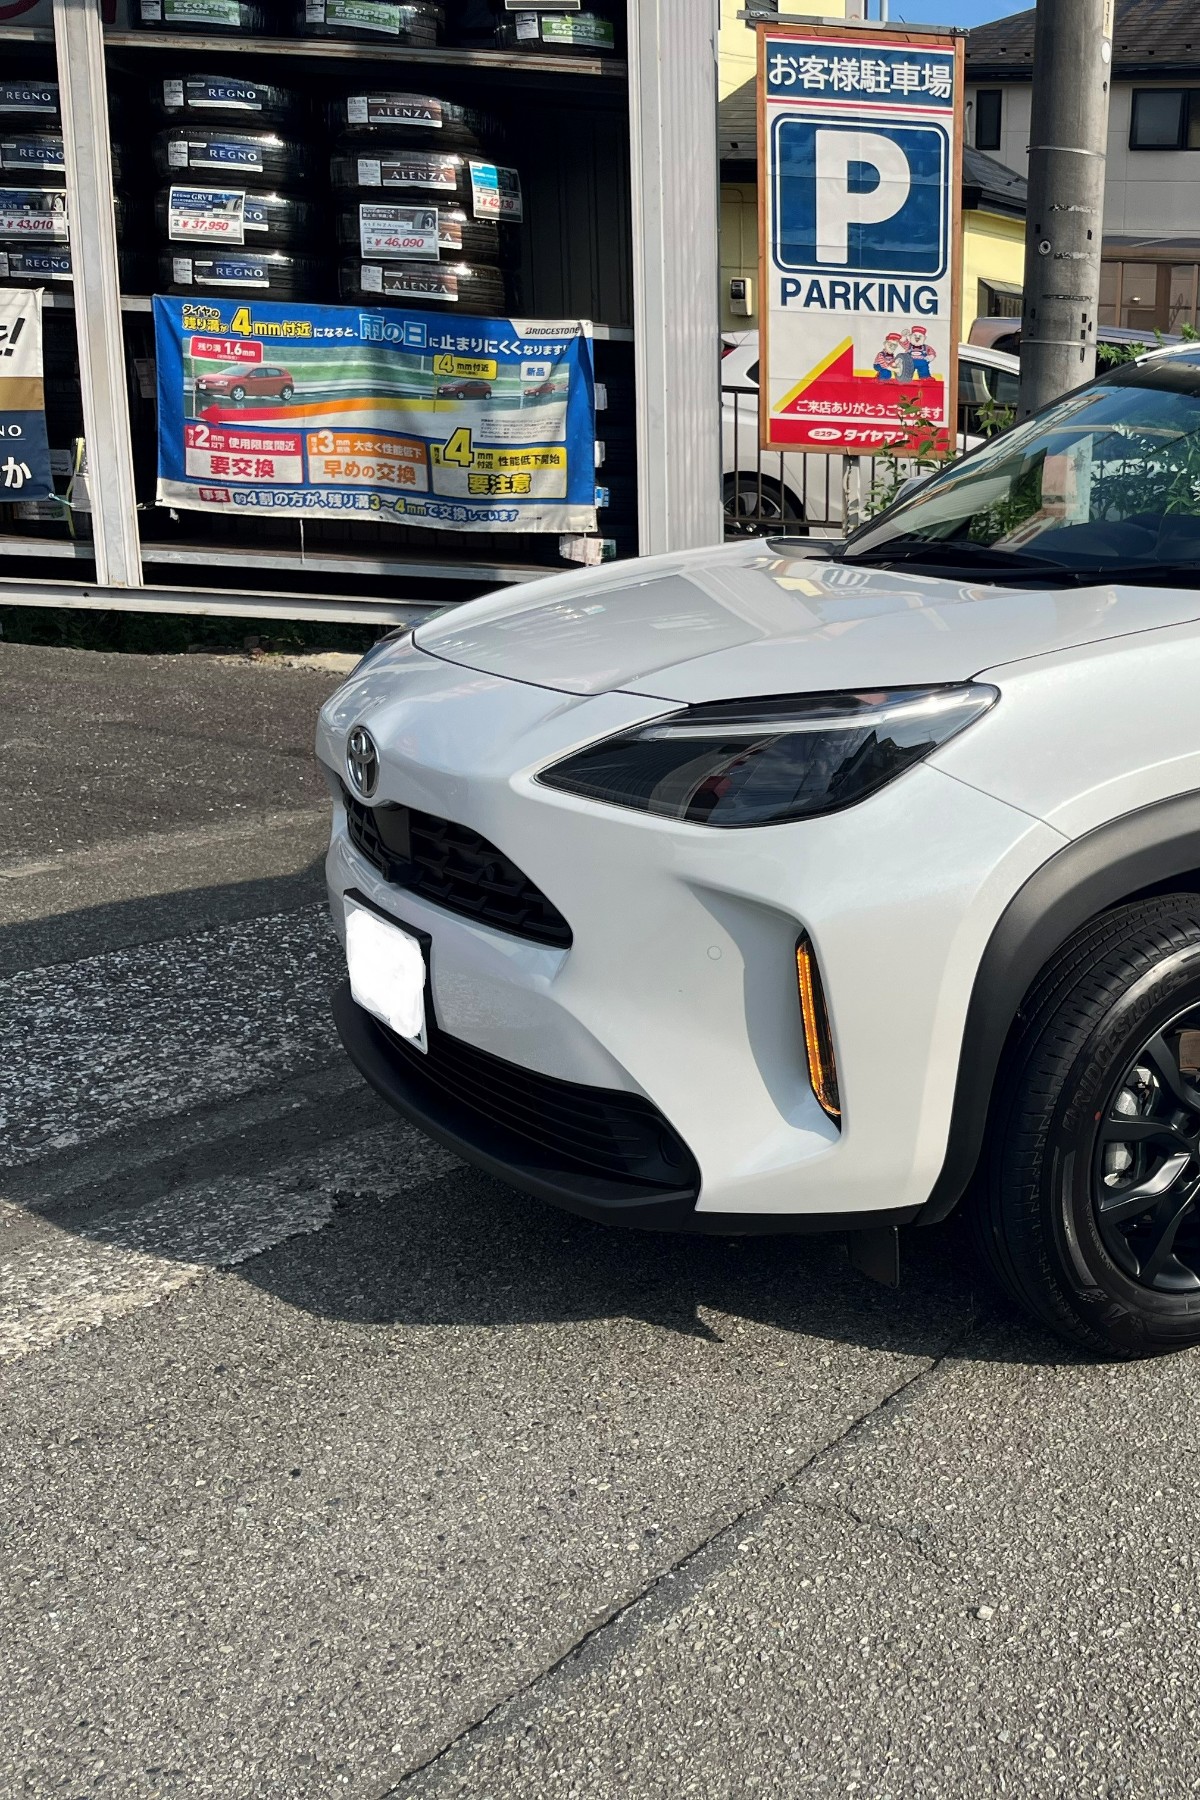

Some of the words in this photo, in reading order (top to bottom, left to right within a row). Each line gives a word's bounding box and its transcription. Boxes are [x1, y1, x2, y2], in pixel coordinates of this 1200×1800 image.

[769, 54, 952, 98] お客様駐車場
[6, 91, 51, 101] REGNO
[208, 88, 256, 99] REGNO
[377, 107, 432, 119] ALENZA
[19, 148, 64, 160] REGNO
[209, 149, 258, 162] REGNO
[391, 171, 447, 182] ALENZA
[815, 129, 911, 265] P
[17, 220, 54, 230] 43,010
[191, 220, 229, 231] 37,950
[384, 238, 424, 248] 46,090
[25, 259, 70, 269] REGNO
[216, 267, 264, 277] REGNO
[392, 281, 449, 293] ALENZA
[780, 277, 939, 315] PARKING
[183, 304, 220, 318] タイヤの
[525, 327, 580, 335] BRIDGESTONE
[526, 367, 546, 377] 新品
[210, 456, 275, 478] 要交換
[323, 460, 417, 485] 早めの交換
[468, 473, 531, 495] 要注意
